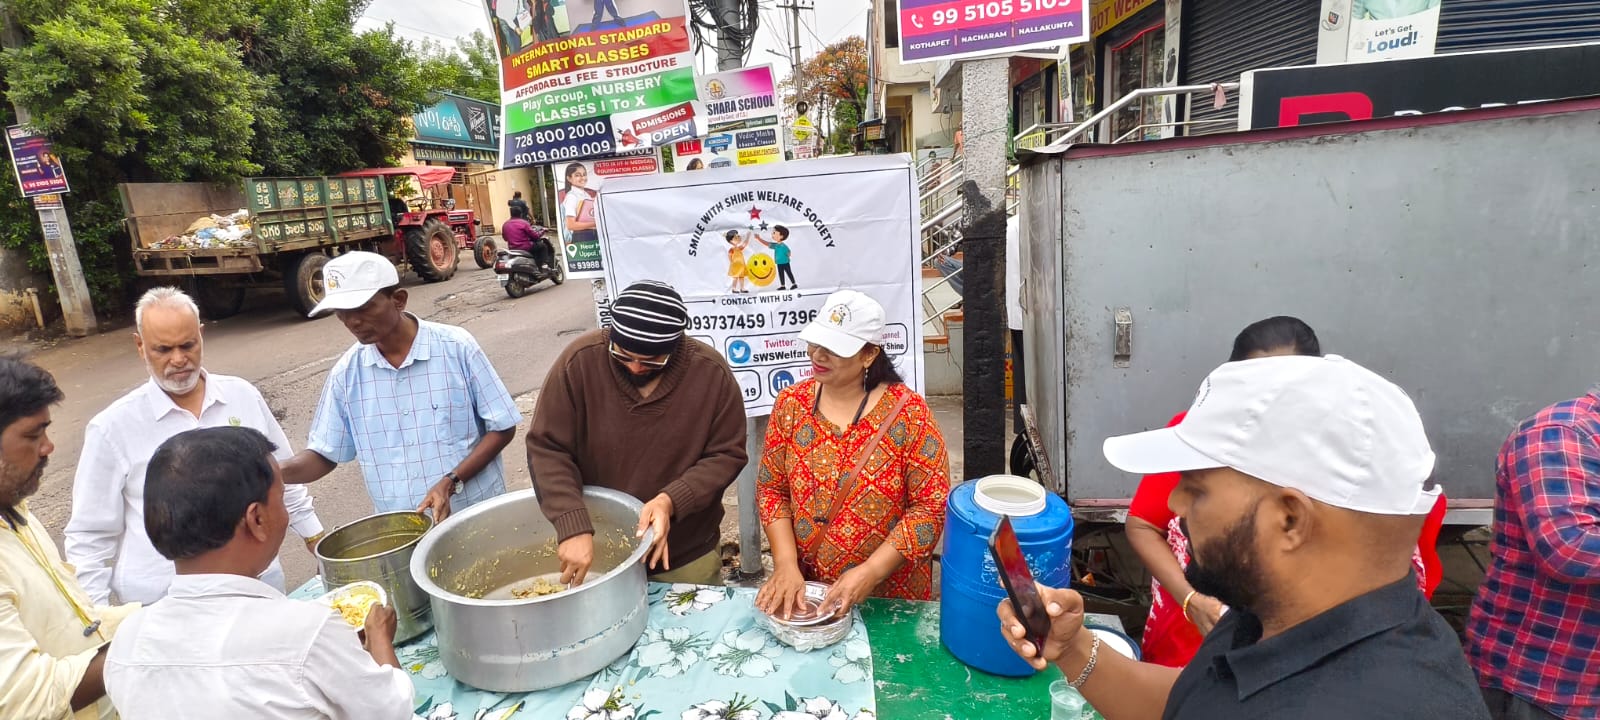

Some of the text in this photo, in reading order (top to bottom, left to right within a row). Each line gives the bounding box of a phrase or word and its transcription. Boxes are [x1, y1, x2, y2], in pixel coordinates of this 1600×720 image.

[932, 8, 958, 26] 99
[964, 2, 1013, 21] 5105
[910, 21, 1074, 50] KOTHAPET NACHARAM NALLAKUNTA
[1367, 31, 1418, 53] Loud!
[1375, 24, 1413, 37] Let's Get
[511, 22, 671, 68] INTERNATIONAL STANDARD
[526, 43, 650, 79] SMART CLASSES
[515, 57, 677, 99] AFFORDABLE FEE STRUCTURE
[522, 75, 663, 113] Play Group, NURSERY
[738, 95, 774, 111] SCHOOL
[534, 95, 646, 124] CLASSES I To X
[635, 107, 687, 132] ADMISSIONS
[515, 121, 606, 149] 728 800 2000
[652, 122, 690, 143] OPEN
[416, 149, 456, 160] RESTAURANT
[514, 140, 611, 166] 8019 008 009
[688, 190, 836, 257] SMILE WITH SHINE WELFARE SOCIETY
[721, 294, 793, 306] CONTACT WITH US
[764, 339, 797, 349] Twitter:
[886, 342, 905, 350] Shine
[745, 388, 756, 397] 19
